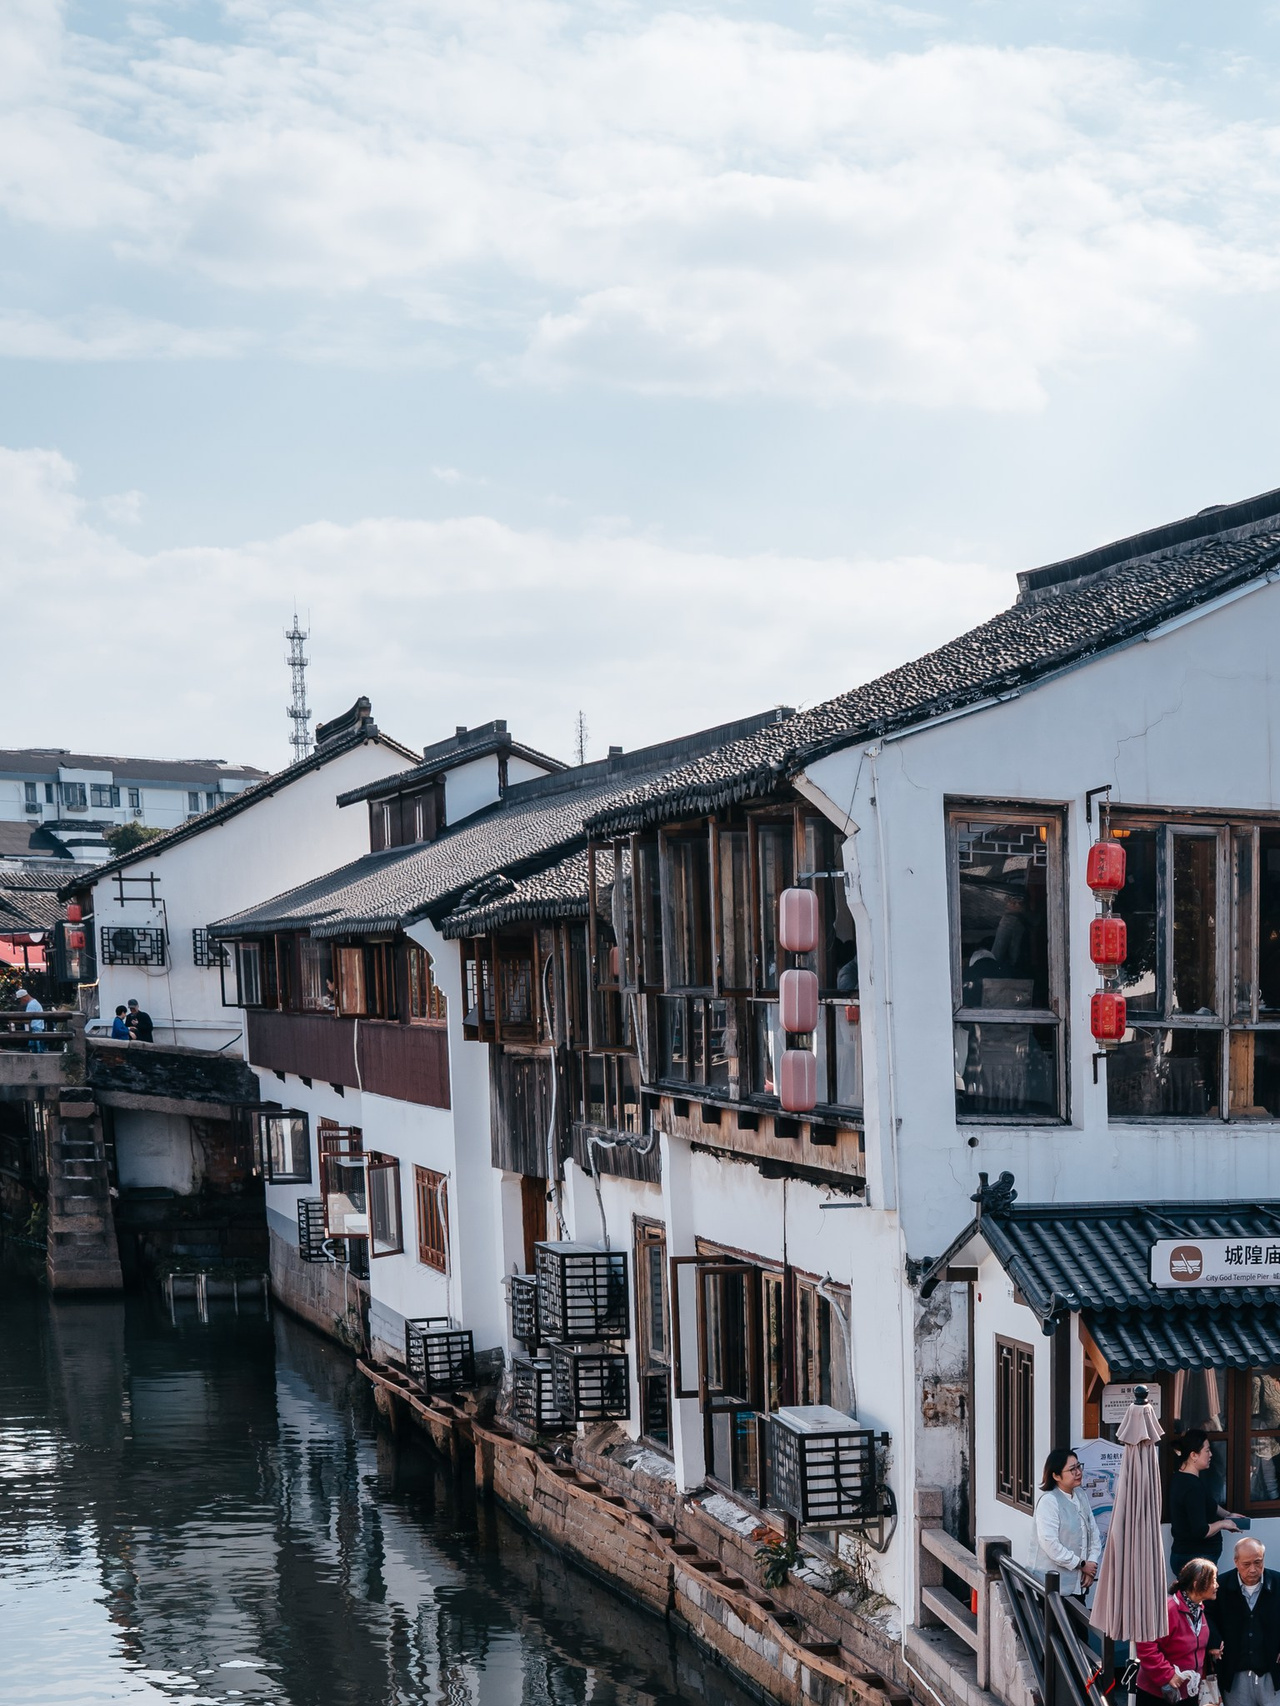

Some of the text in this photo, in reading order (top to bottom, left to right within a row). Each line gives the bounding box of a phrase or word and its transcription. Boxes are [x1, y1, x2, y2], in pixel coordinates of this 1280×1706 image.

[1205, 1274, 1218, 1283] City
[1219, 1273, 1233, 1281] God
[1233, 1273, 1256, 1282] Temple
